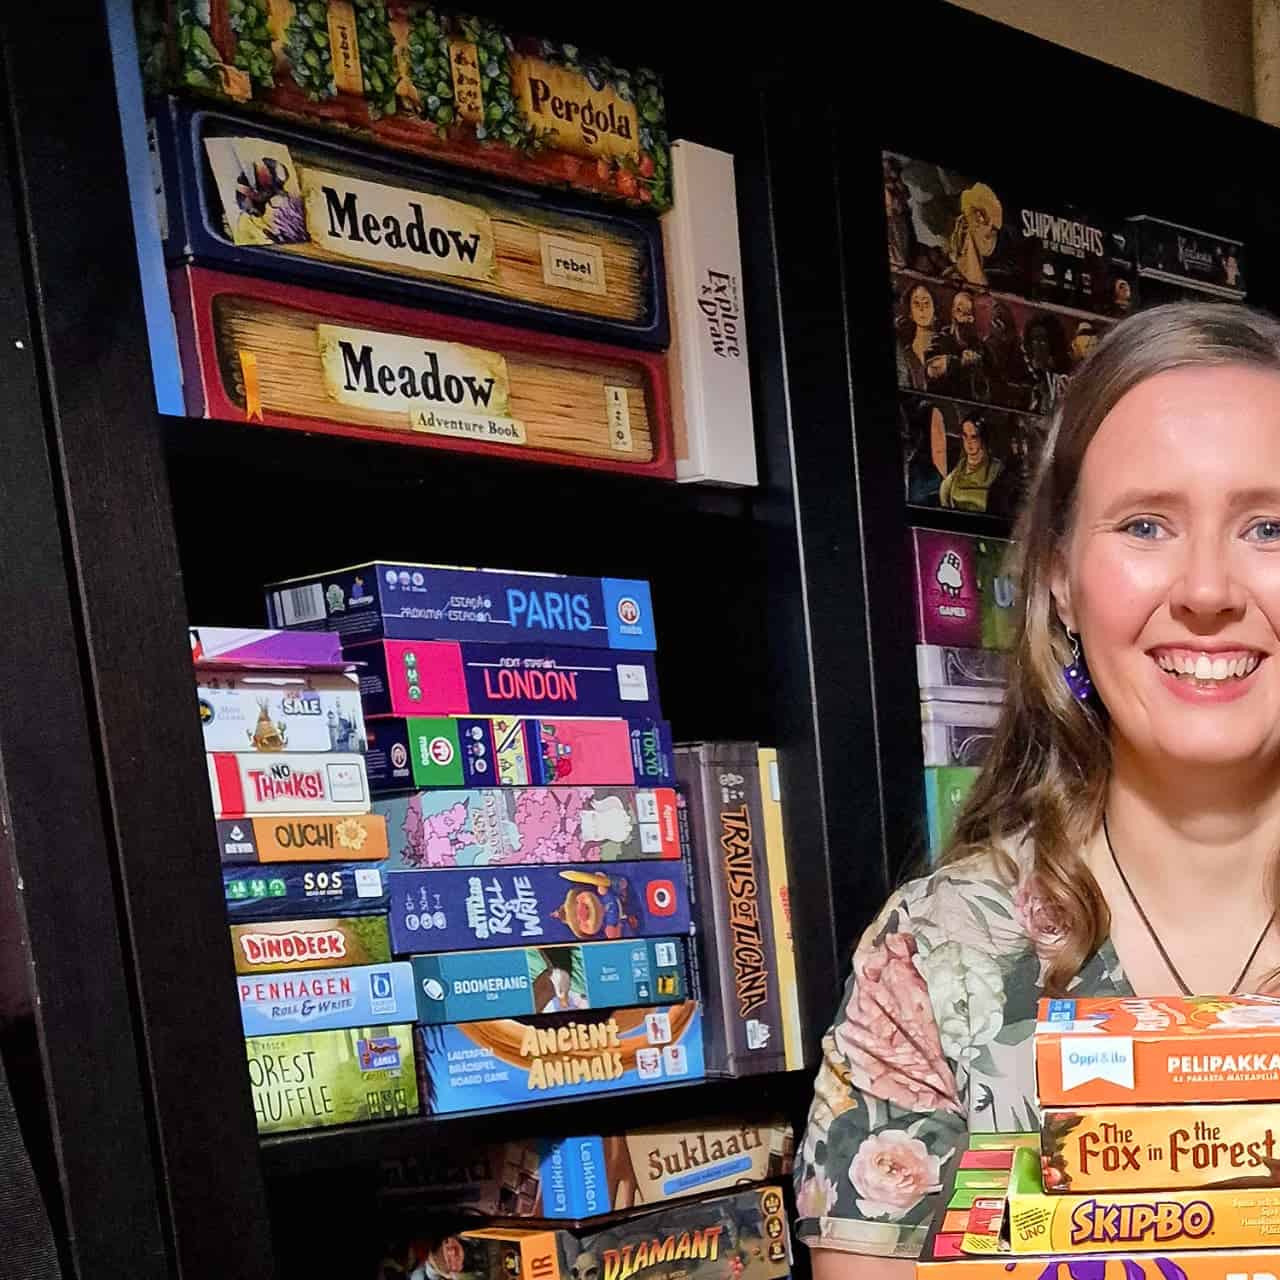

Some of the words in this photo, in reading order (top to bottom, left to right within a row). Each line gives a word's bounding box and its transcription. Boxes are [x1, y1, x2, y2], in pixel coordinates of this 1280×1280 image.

[528, 77, 632, 145] Pergola
[321, 185, 481, 265] Meadow
[1021, 208, 1105, 258] SHIPWRIGHTS
[554, 256, 592, 276] rebel
[700, 296, 727, 359] Draw
[707, 268, 741, 358] Explore
[338, 339, 496, 408] Meadow
[417, 412, 485, 434] Adventure
[487, 420, 520, 440] Book
[506, 588, 592, 631] PARIS
[483, 668, 578, 701] LONDON
[282, 698, 322, 716] SALE
[271, 763, 291, 780] NO
[720, 804, 756, 902] TRAILS
[485, 876, 513, 936] ROLL
[513, 875, 544, 938] WRITE
[240, 974, 352, 1003] PENHAGEN
[453, 975, 529, 995] BOOMERANG
[731, 917, 769, 1019] TUCANA
[271, 1002, 299, 1019] ROLL
[300, 999, 318, 1017] &
[317, 999, 353, 1014] WRITE
[249, 1050, 317, 1088] OREST
[253, 1085, 335, 1124] HUFFLE
[1078, 1130, 1141, 1175] Fox
[1147, 1144, 1163, 1163] in
[1099, 1121, 1133, 1144] The
[1169, 1128, 1276, 1174] Forest
[1193, 1121, 1221, 1142] the
[646, 1125, 766, 1182] Suklaati
[1018, 1223, 1047, 1241] UNO
